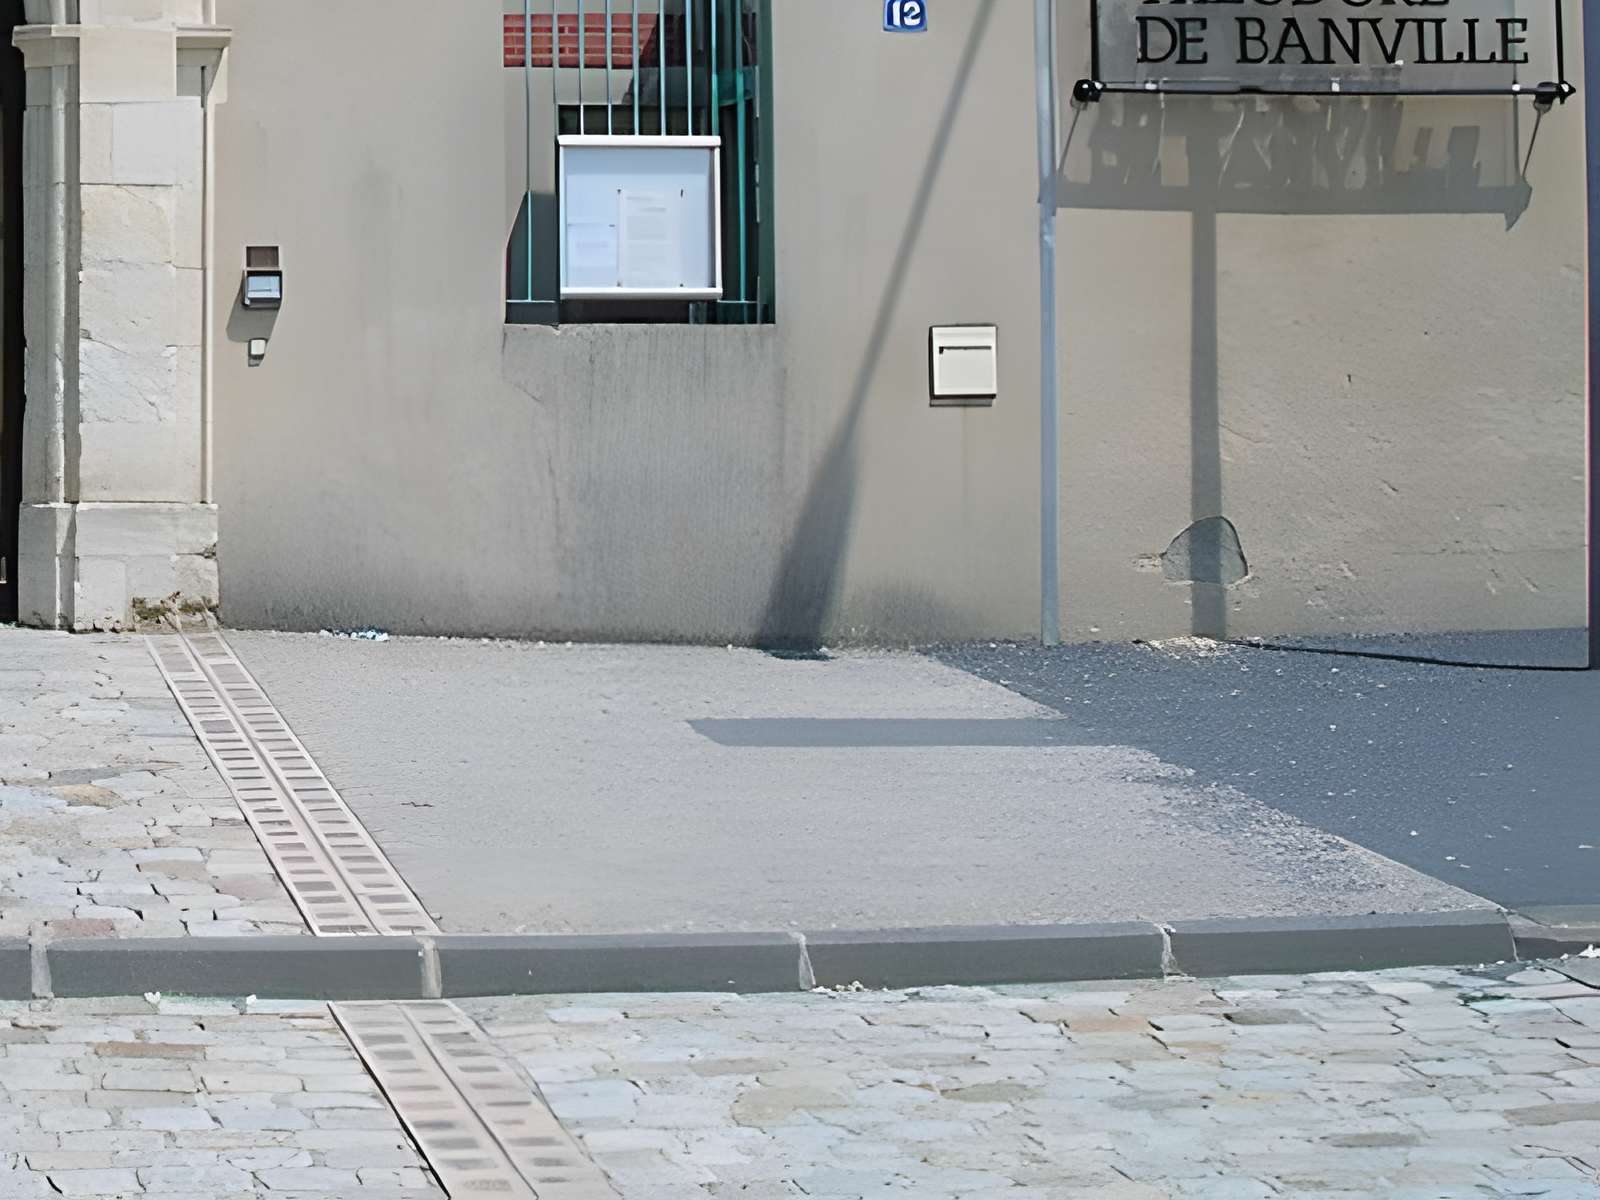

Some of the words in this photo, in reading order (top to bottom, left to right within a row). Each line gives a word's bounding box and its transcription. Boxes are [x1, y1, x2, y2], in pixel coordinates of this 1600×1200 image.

[892, 0, 921, 26] 12
[1135, 15, 1209, 65] DE
[1234, 16, 1529, 65] BANVILLE
